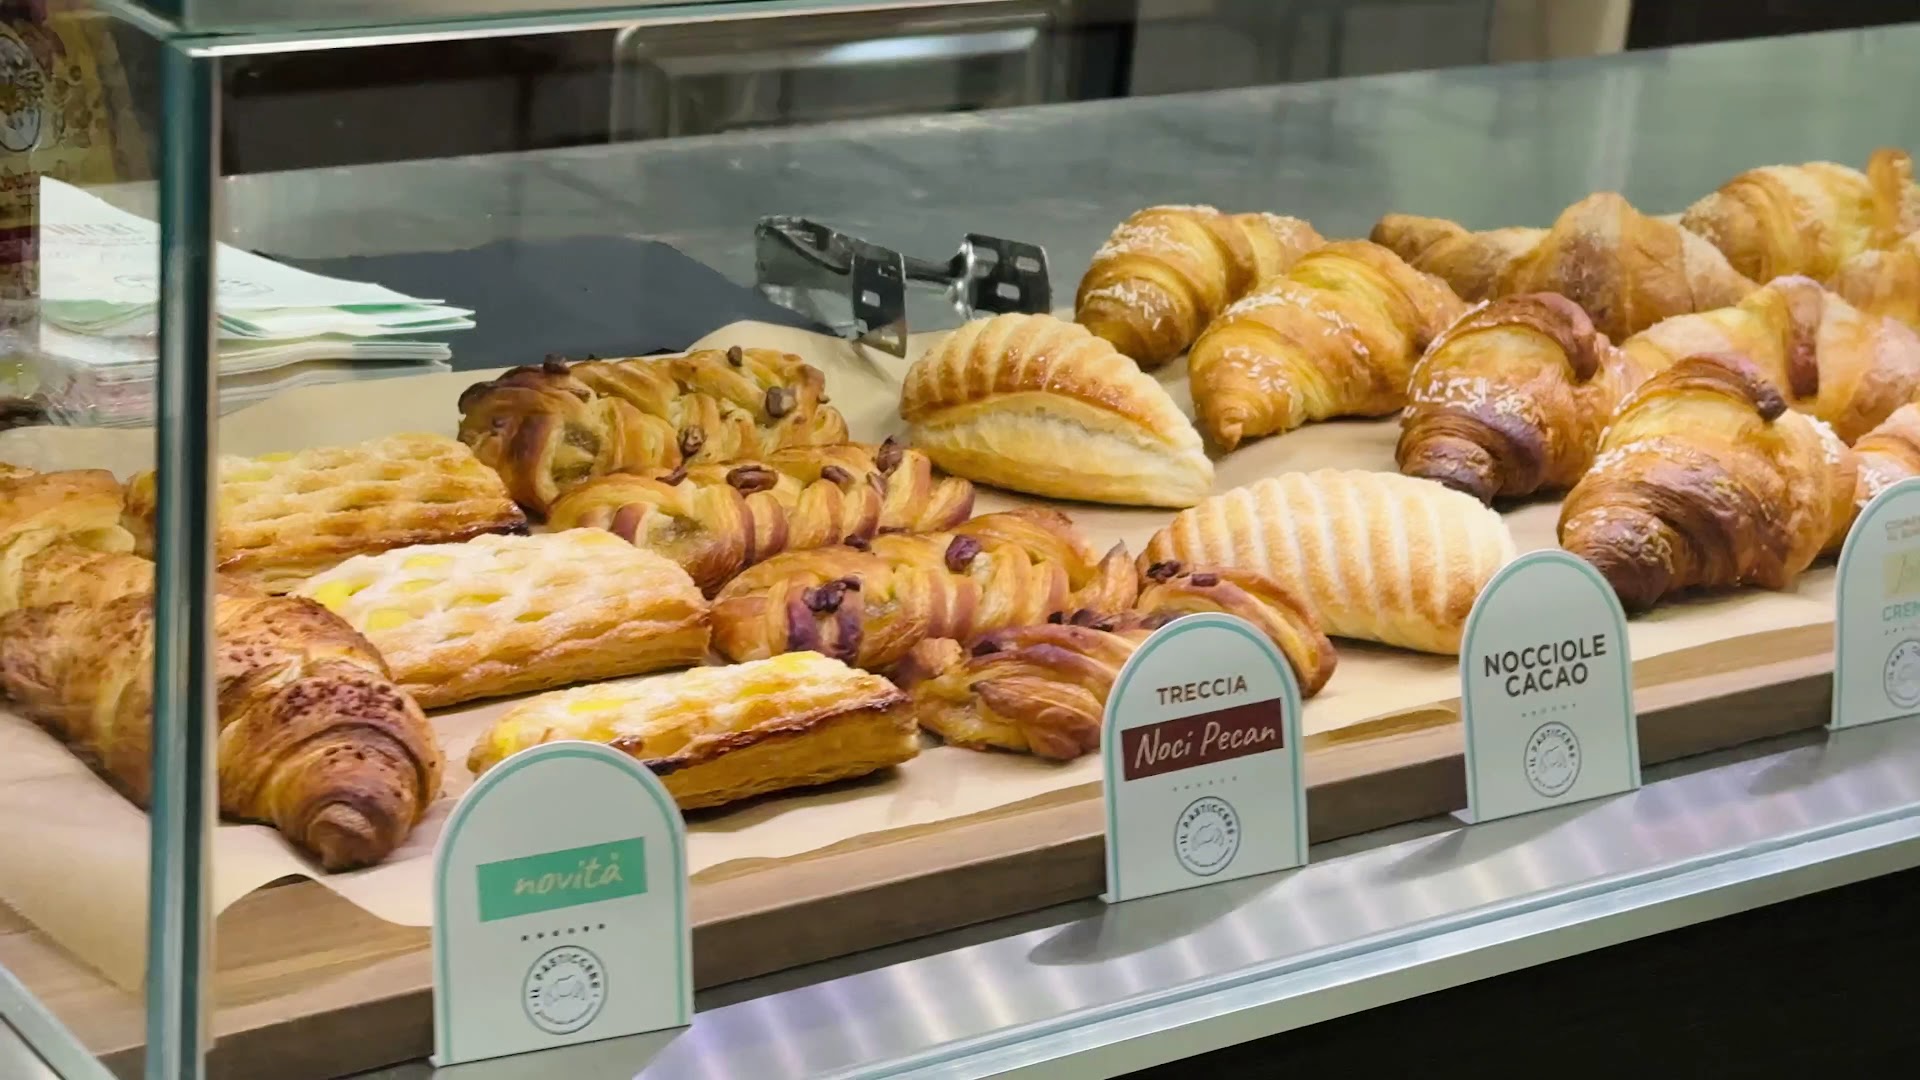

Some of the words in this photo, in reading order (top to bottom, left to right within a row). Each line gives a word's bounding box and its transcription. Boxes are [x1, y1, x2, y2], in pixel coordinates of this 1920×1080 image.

[1484, 634, 1606, 677] NOCCIOLE
[1156, 675, 1247, 705] TRECCIA
[1505, 662, 1588, 697] CACAO
[1134, 728, 1192, 769] Noci
[1200, 721, 1276, 757] Pecan
[514, 853, 624, 895] novità
